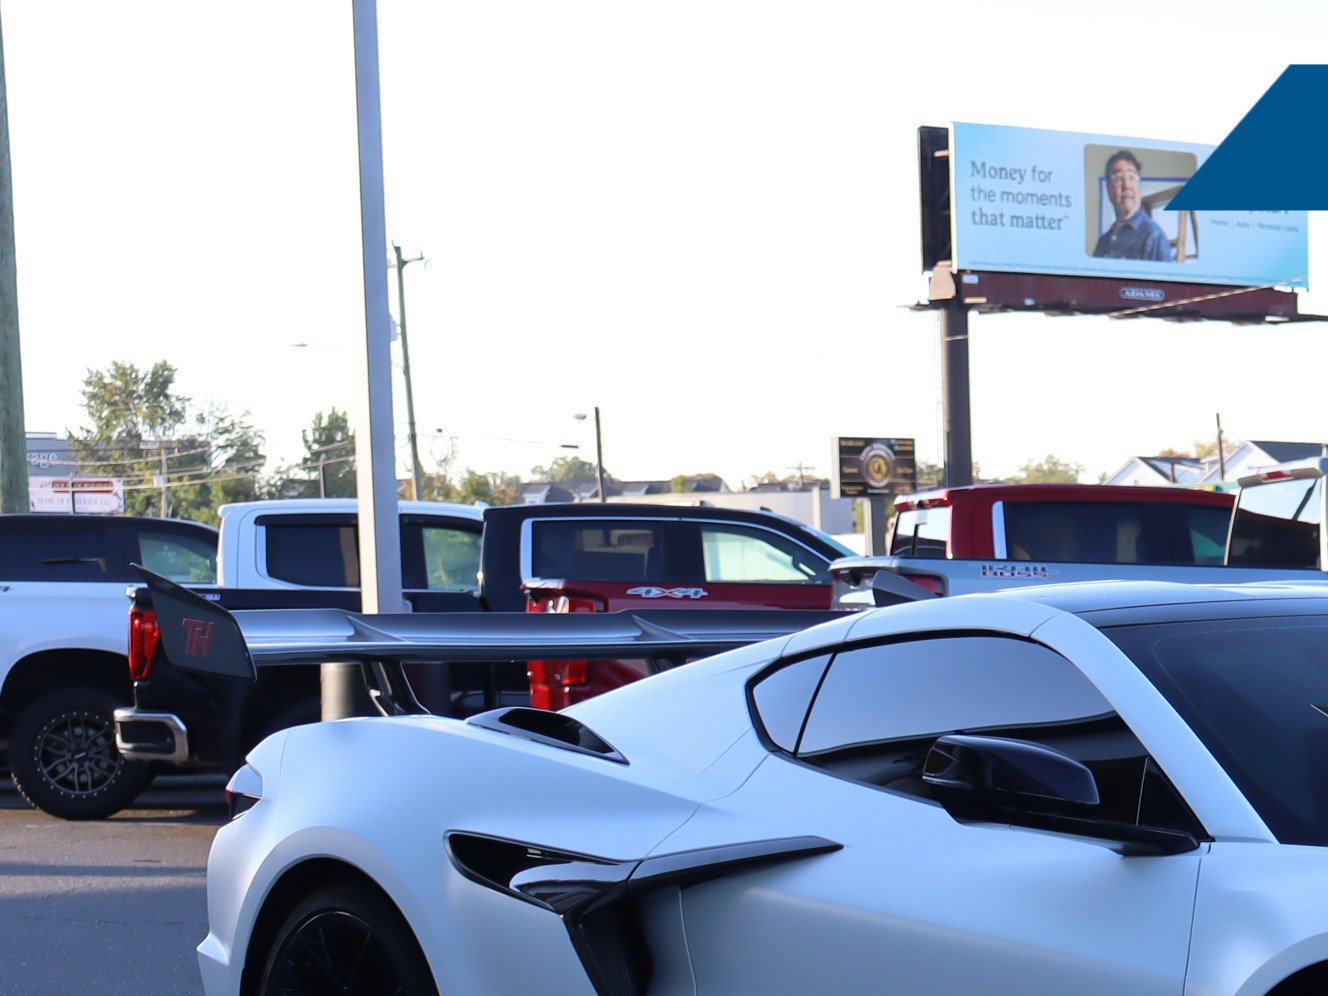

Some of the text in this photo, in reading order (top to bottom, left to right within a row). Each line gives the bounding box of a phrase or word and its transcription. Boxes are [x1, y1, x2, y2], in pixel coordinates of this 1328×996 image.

[970, 160, 1053, 185] Money for
[970, 185, 1072, 208] the moments
[971, 206, 1064, 231] that matter
